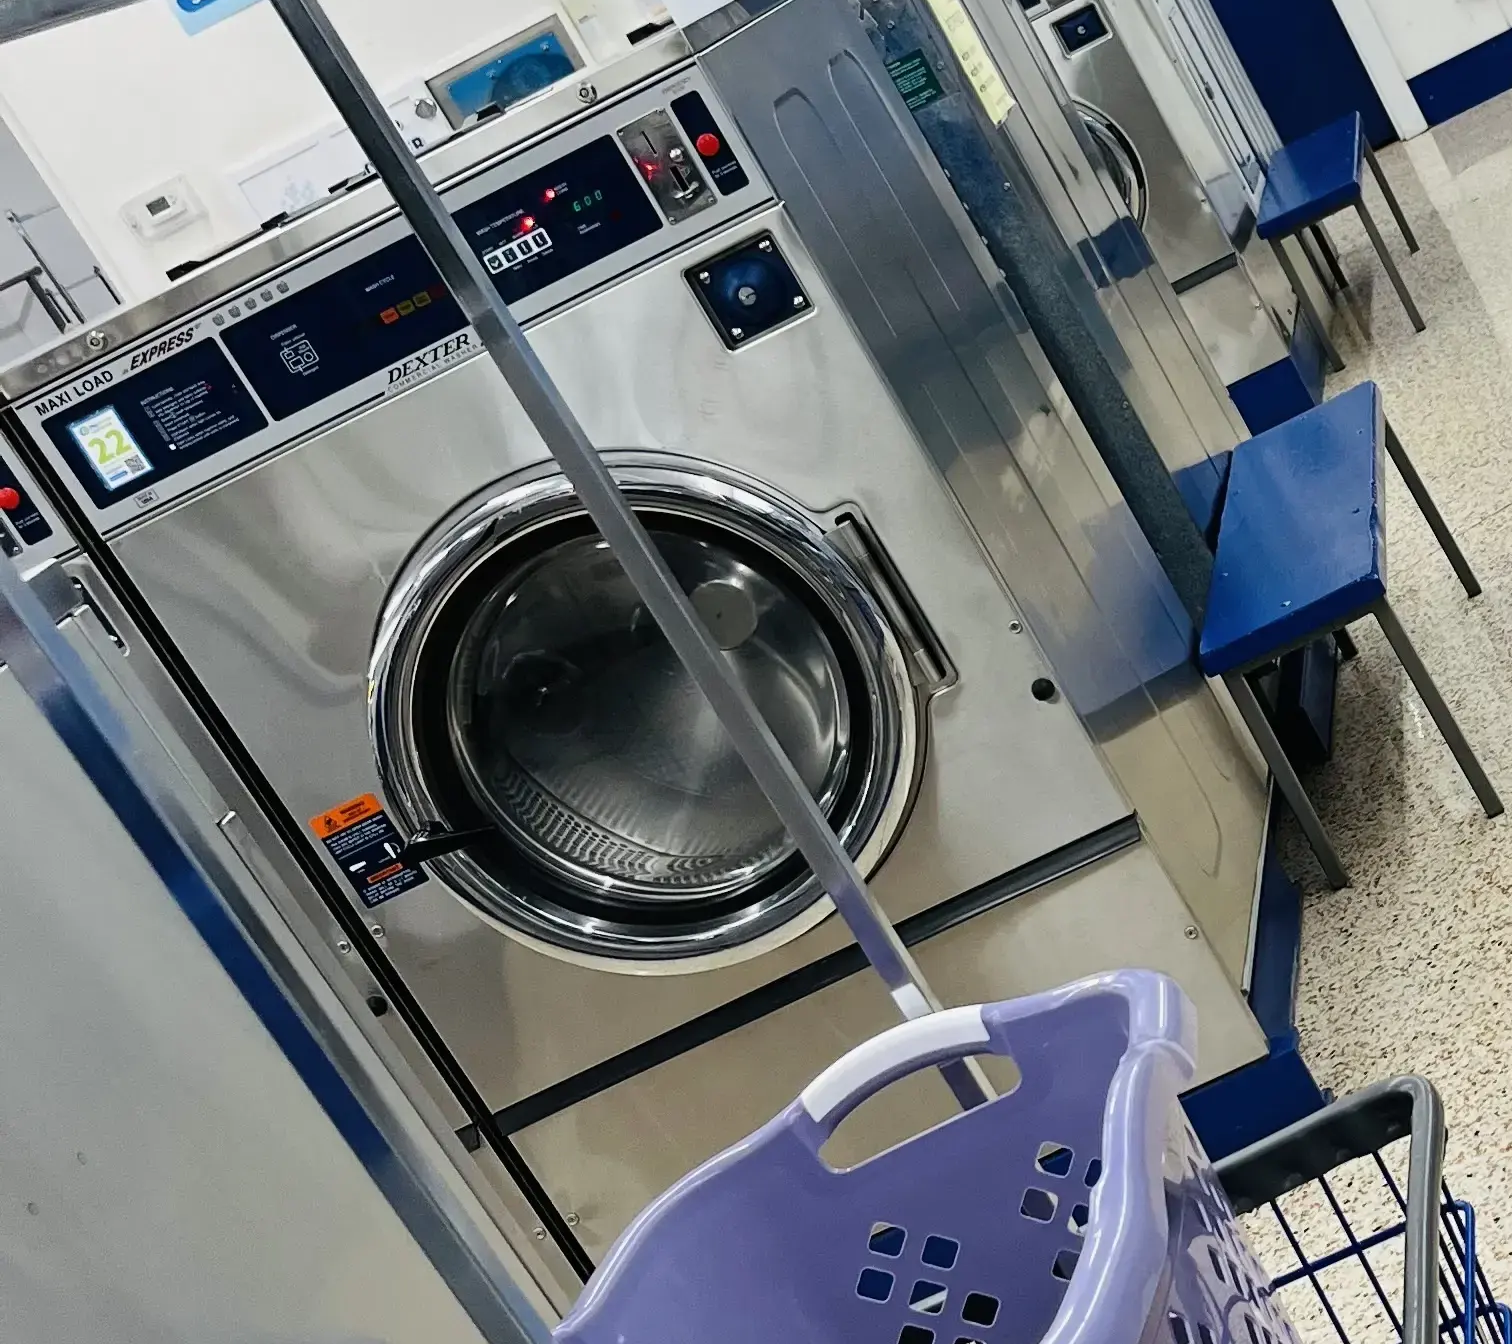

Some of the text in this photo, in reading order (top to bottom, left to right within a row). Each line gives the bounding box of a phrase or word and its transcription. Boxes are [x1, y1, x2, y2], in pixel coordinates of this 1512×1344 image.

[34, 327, 195, 416] MAXI LOAD EXPRESS
[388, 333, 471, 384] DEXTER
[388, 362, 441, 393] COMMERCIAL
[88, 429, 132, 464] 22
